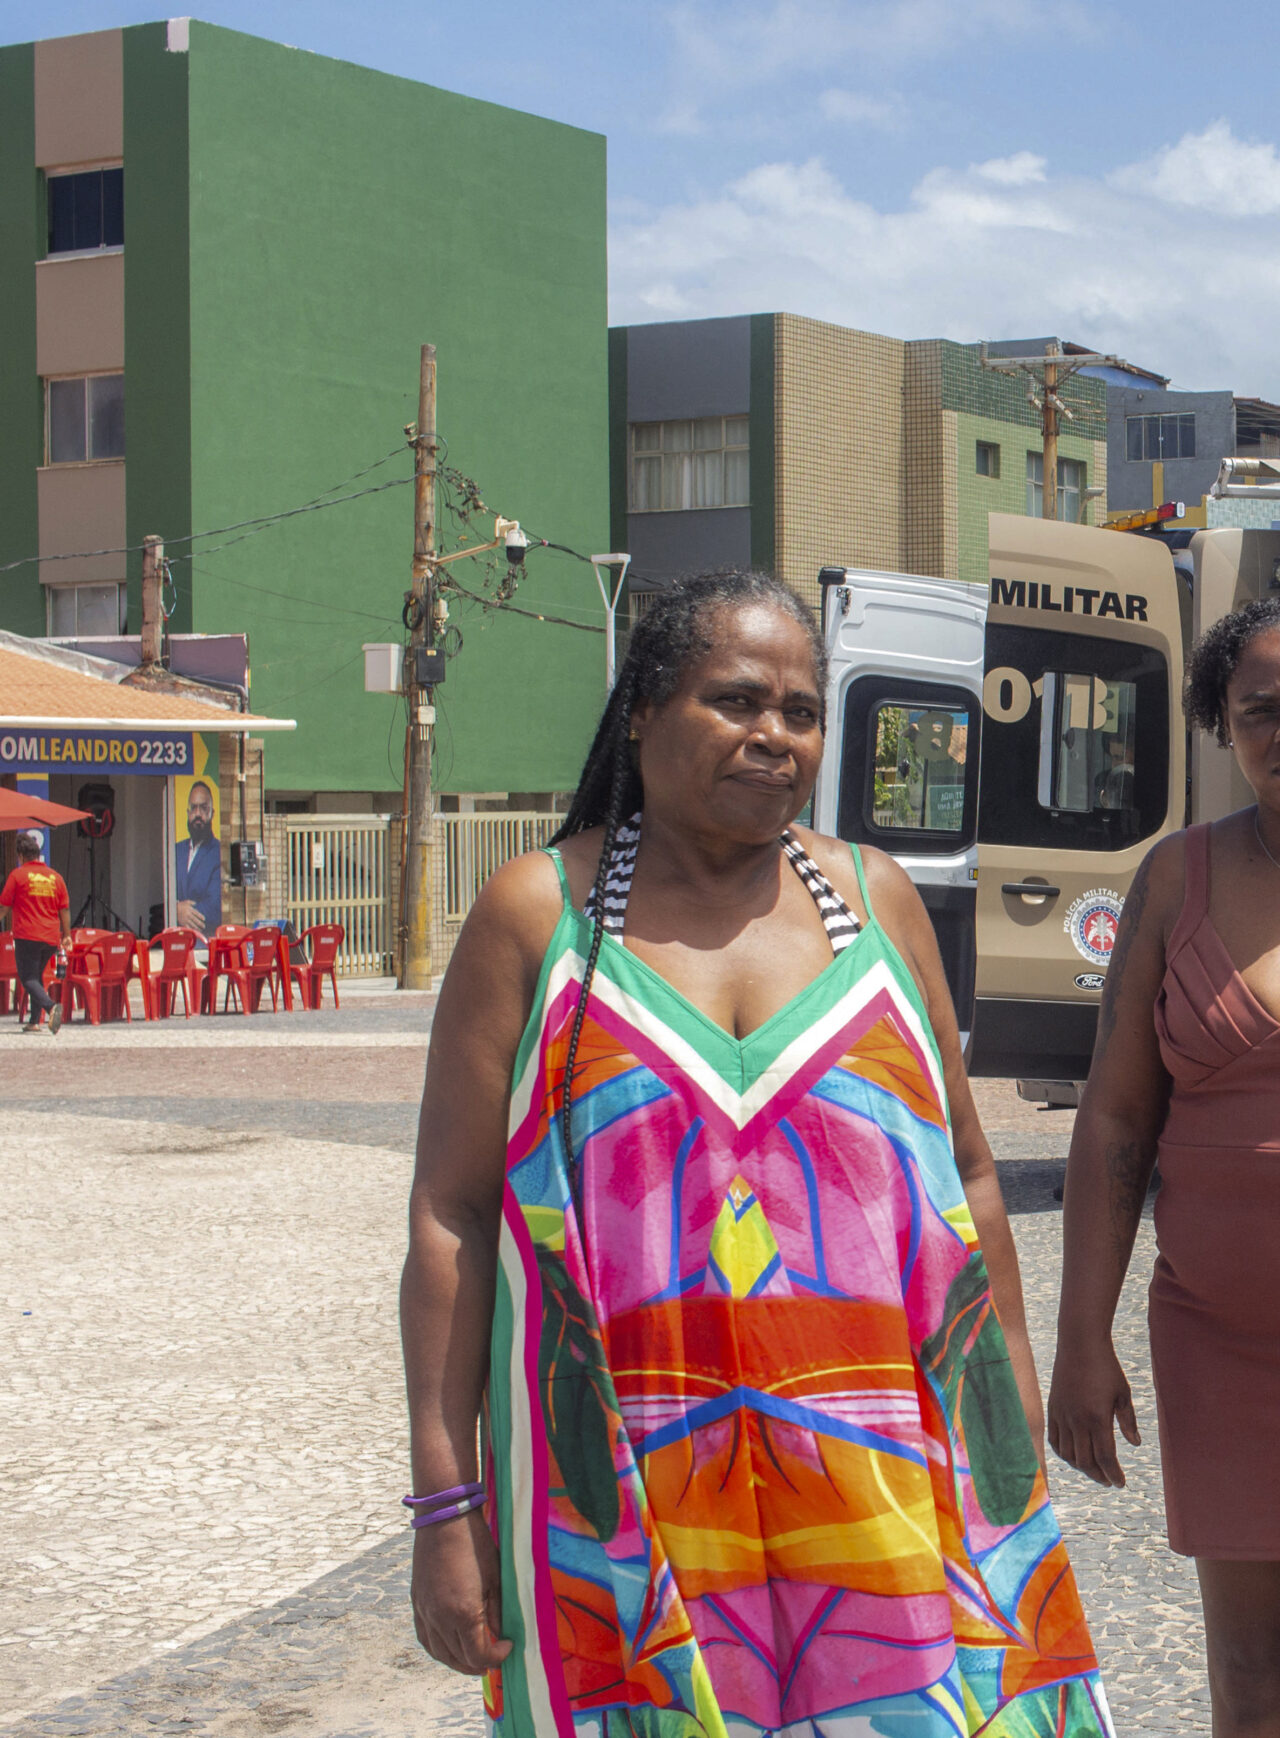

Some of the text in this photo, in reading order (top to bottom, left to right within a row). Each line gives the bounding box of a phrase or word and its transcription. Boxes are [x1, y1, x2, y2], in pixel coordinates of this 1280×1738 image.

[990, 577, 1148, 622] MILITAR
[1063, 897, 1083, 933] POLÍCIA
[1083, 887, 1118, 900] MILITAR
[1081, 976, 1102, 987] Ford
